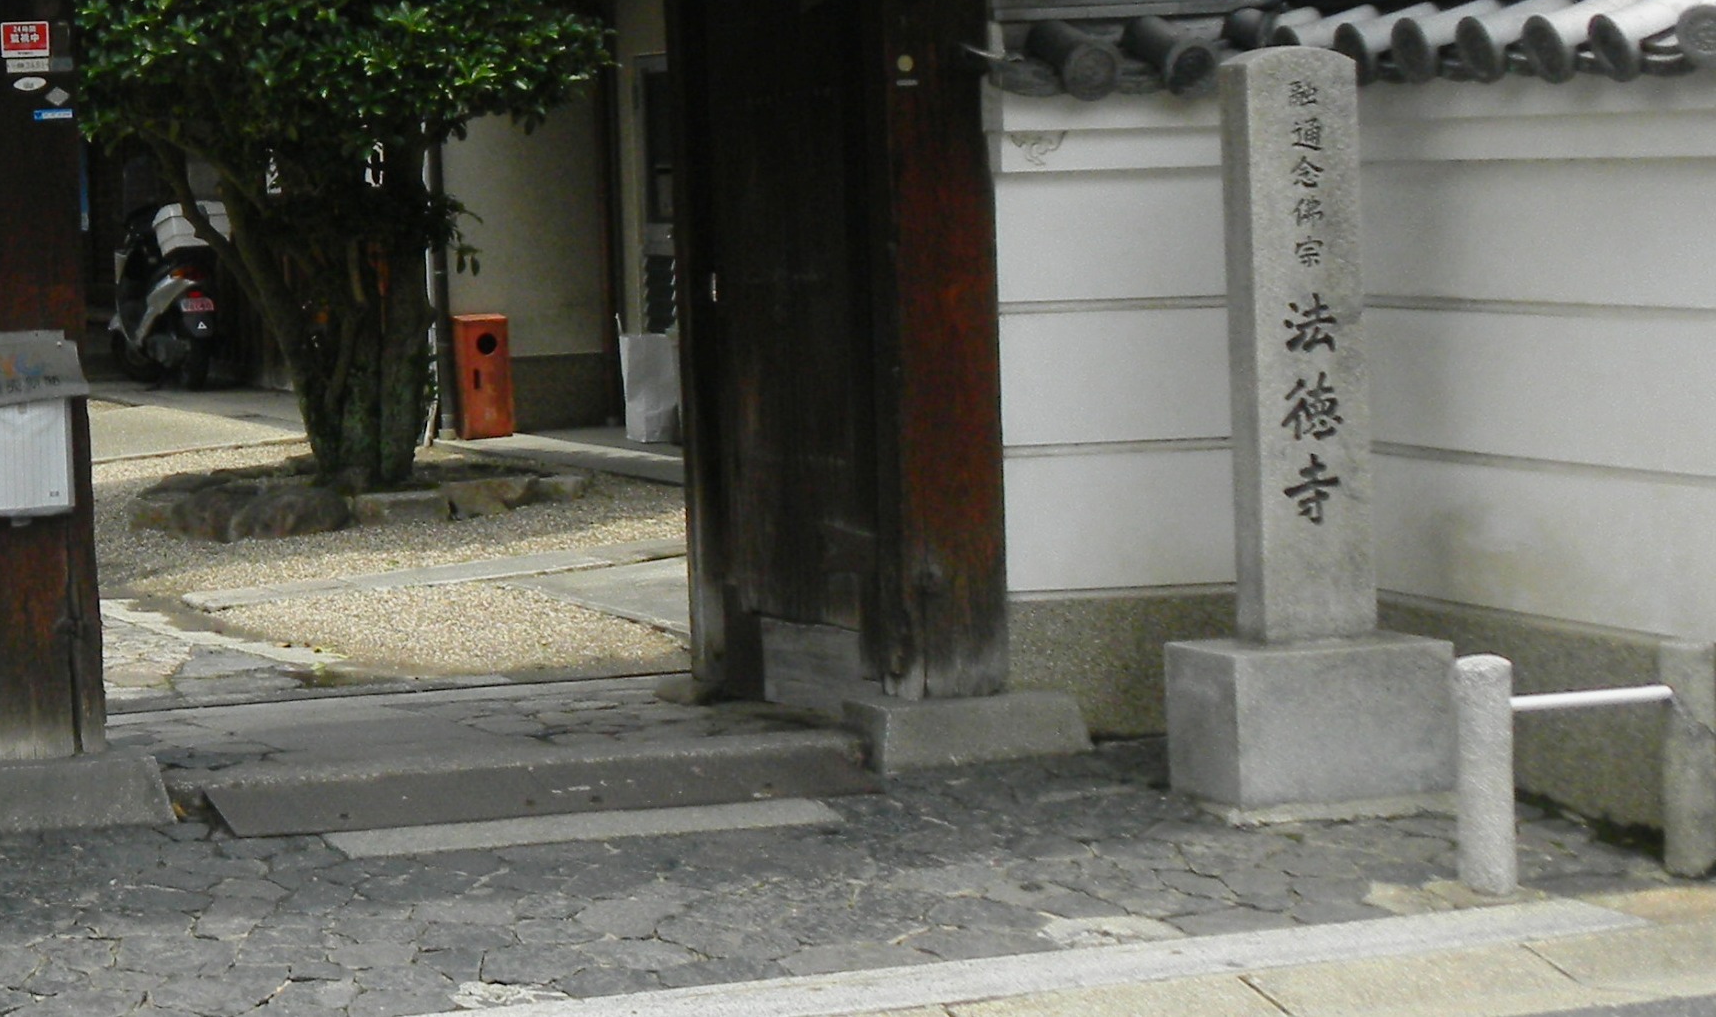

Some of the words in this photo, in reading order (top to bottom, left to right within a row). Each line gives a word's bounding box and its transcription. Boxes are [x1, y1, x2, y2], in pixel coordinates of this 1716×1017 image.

[1288, 80, 1325, 268] 融通念佛宗
[1281, 291, 1345, 526] 法徳寺
